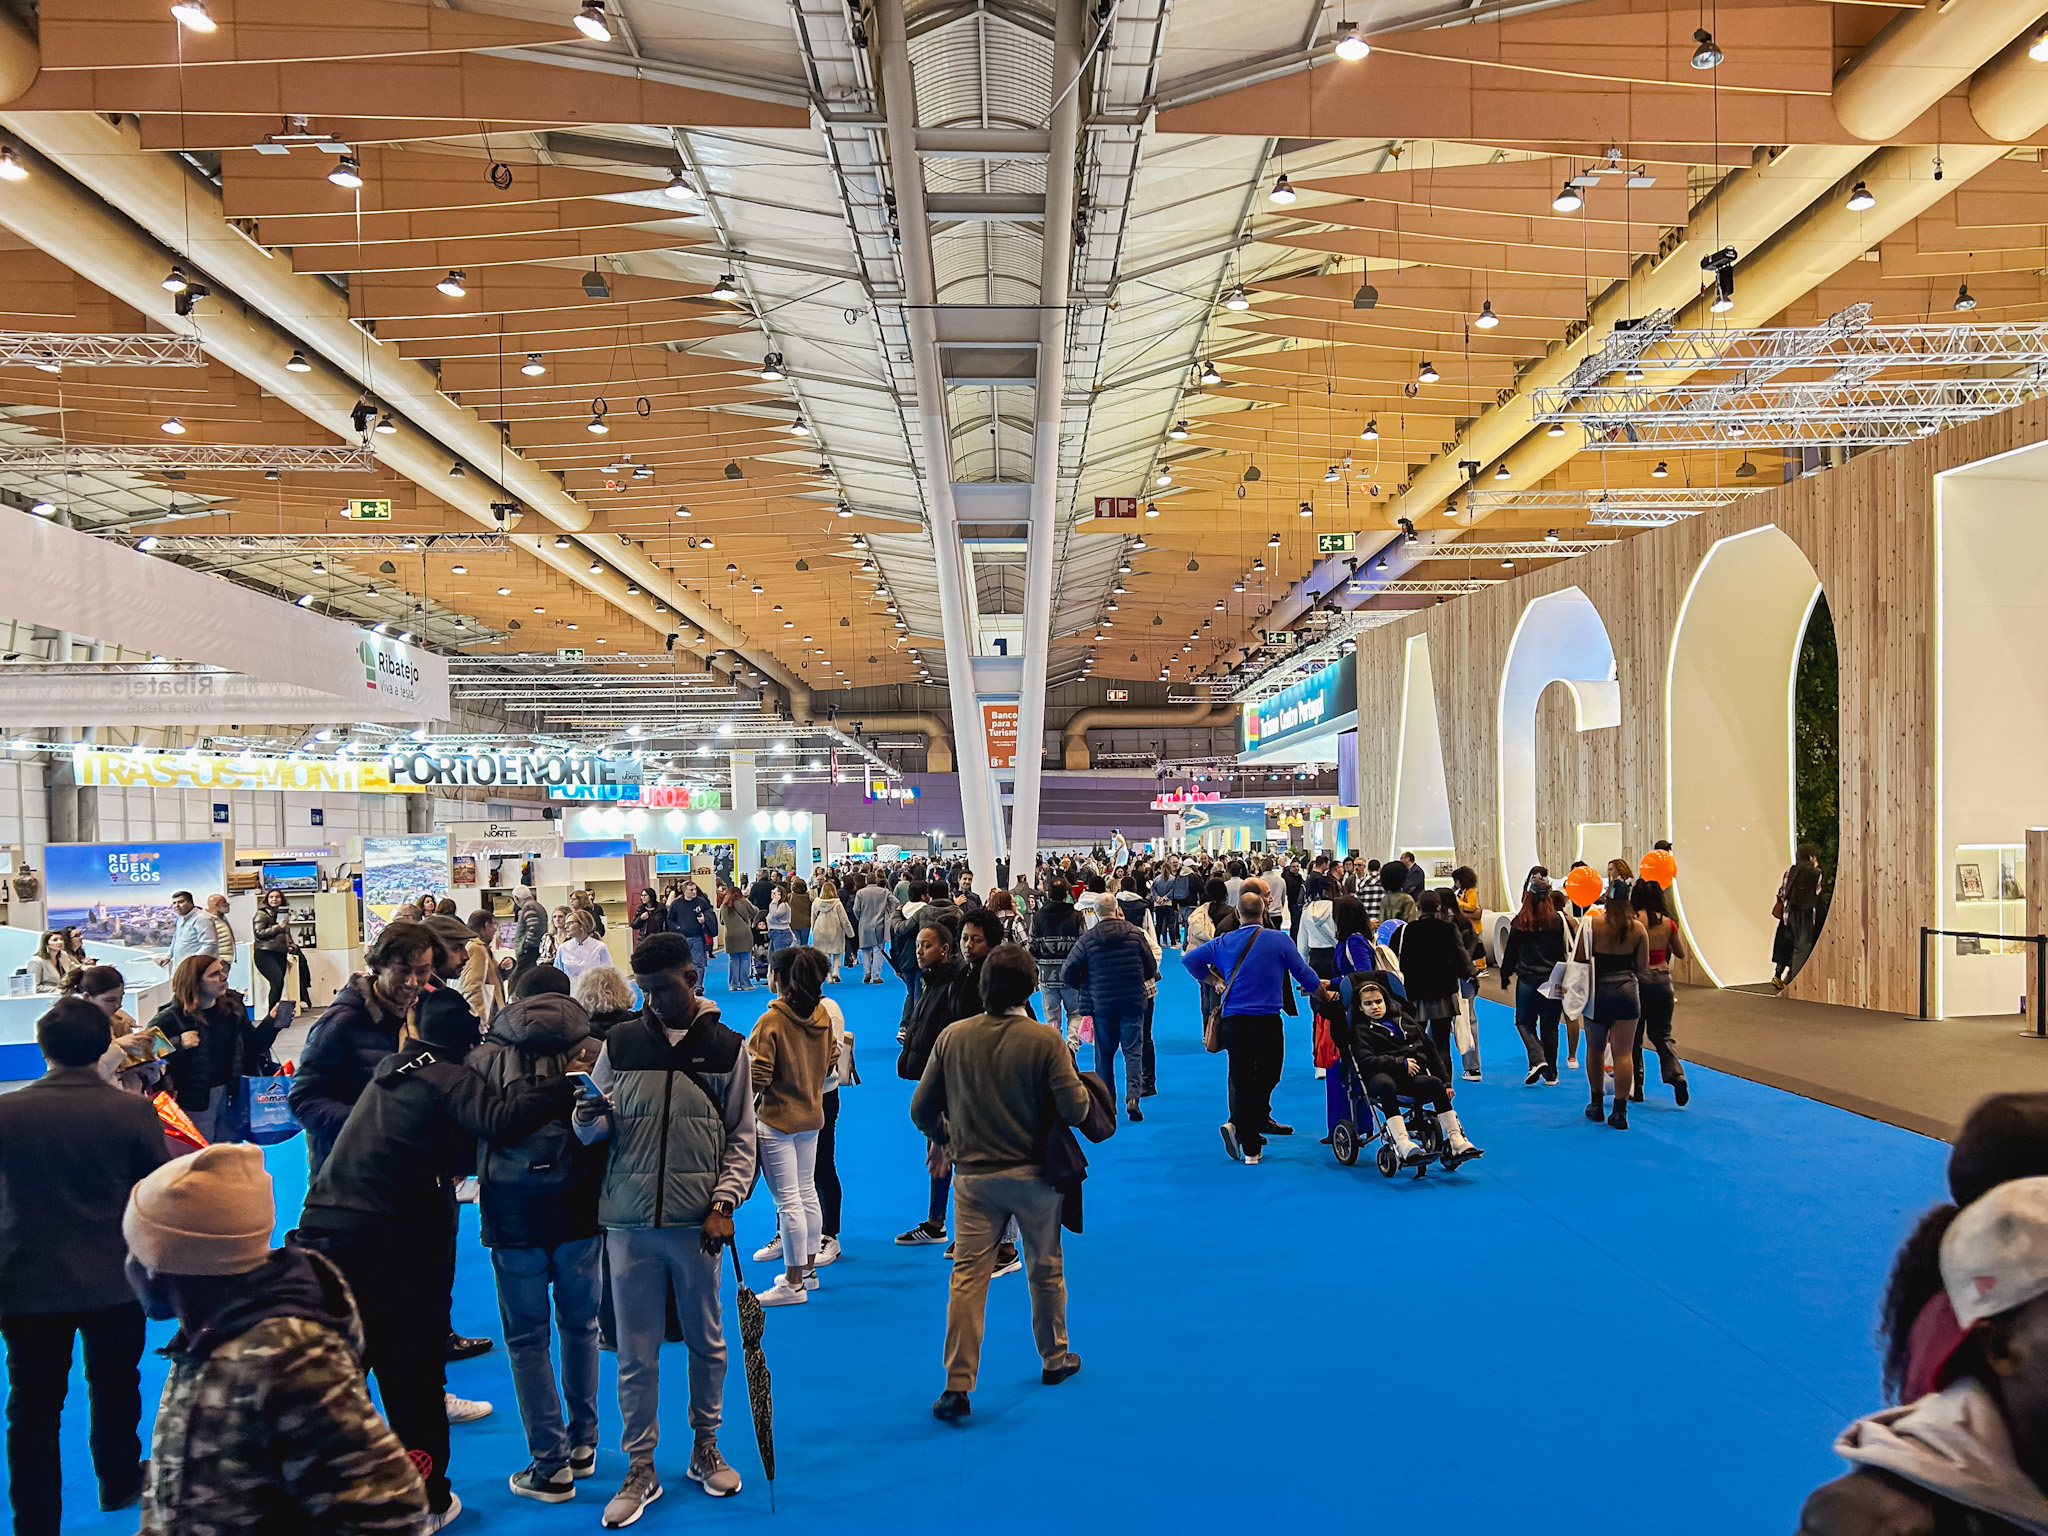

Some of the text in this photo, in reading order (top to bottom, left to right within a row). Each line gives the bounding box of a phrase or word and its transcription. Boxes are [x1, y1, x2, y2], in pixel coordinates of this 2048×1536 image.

[378, 652, 419, 685] Ribatejo
[381, 680, 415, 700] Viva a festa
[991, 711, 1018, 719] Banco
[1280, 706, 1298, 732] Centro
[1298, 688, 1325, 725] Portugal
[992, 720, 1010, 728] para
[988, 728, 1017, 737] Turism
[484, 830, 517, 838] NORTE
[109, 853, 128, 863] RE
[109, 863, 150, 873] GUEN
[130, 872, 160, 882] GOS
